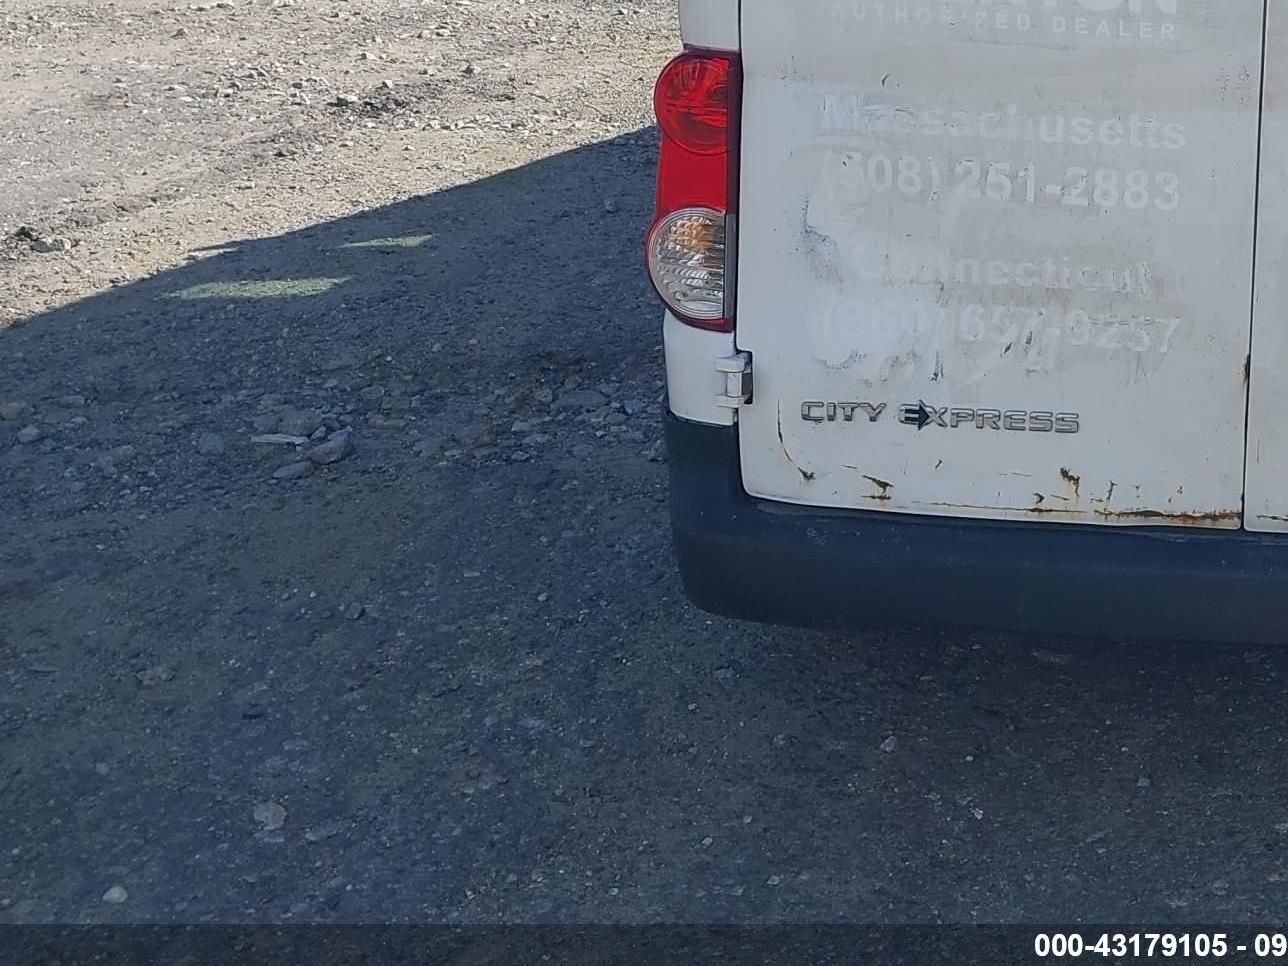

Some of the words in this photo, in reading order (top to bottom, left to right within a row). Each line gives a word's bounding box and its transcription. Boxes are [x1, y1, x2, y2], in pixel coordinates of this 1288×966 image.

[1052, 17, 1177, 41] DEALER
[953, 157, 1182, 211] 251-2883
[801, 401, 887, 423] CITY
[897, 399, 1080, 434] EXPRESS
